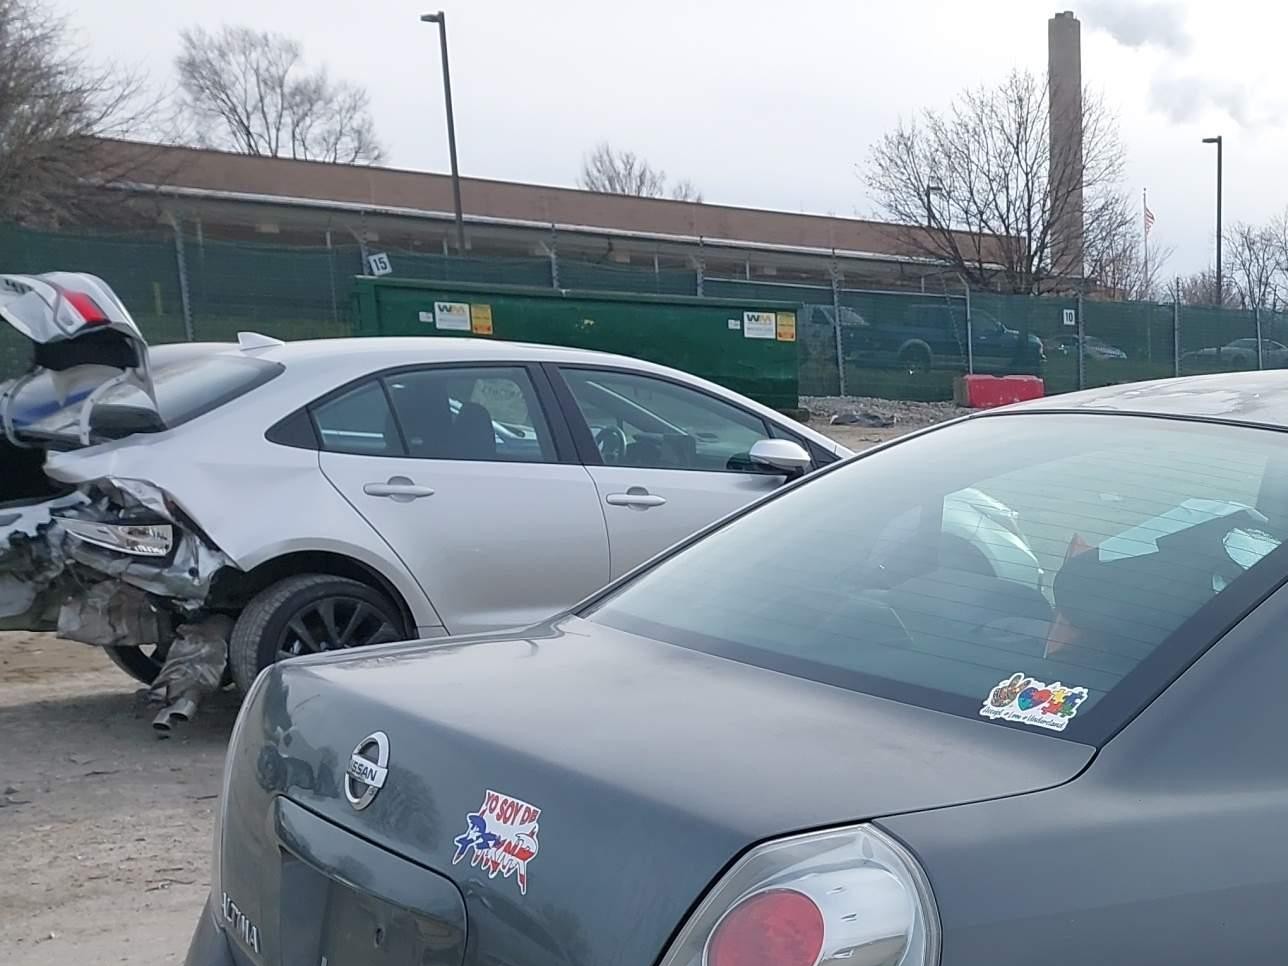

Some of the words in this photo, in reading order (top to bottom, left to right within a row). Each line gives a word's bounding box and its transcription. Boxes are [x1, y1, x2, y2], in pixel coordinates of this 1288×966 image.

[373, 257, 388, 272] 15
[1065, 311, 1074, 322] 10
[485, 791, 499, 815] YO
[495, 798, 524, 826] SOY
[519, 806, 540, 826] DE
